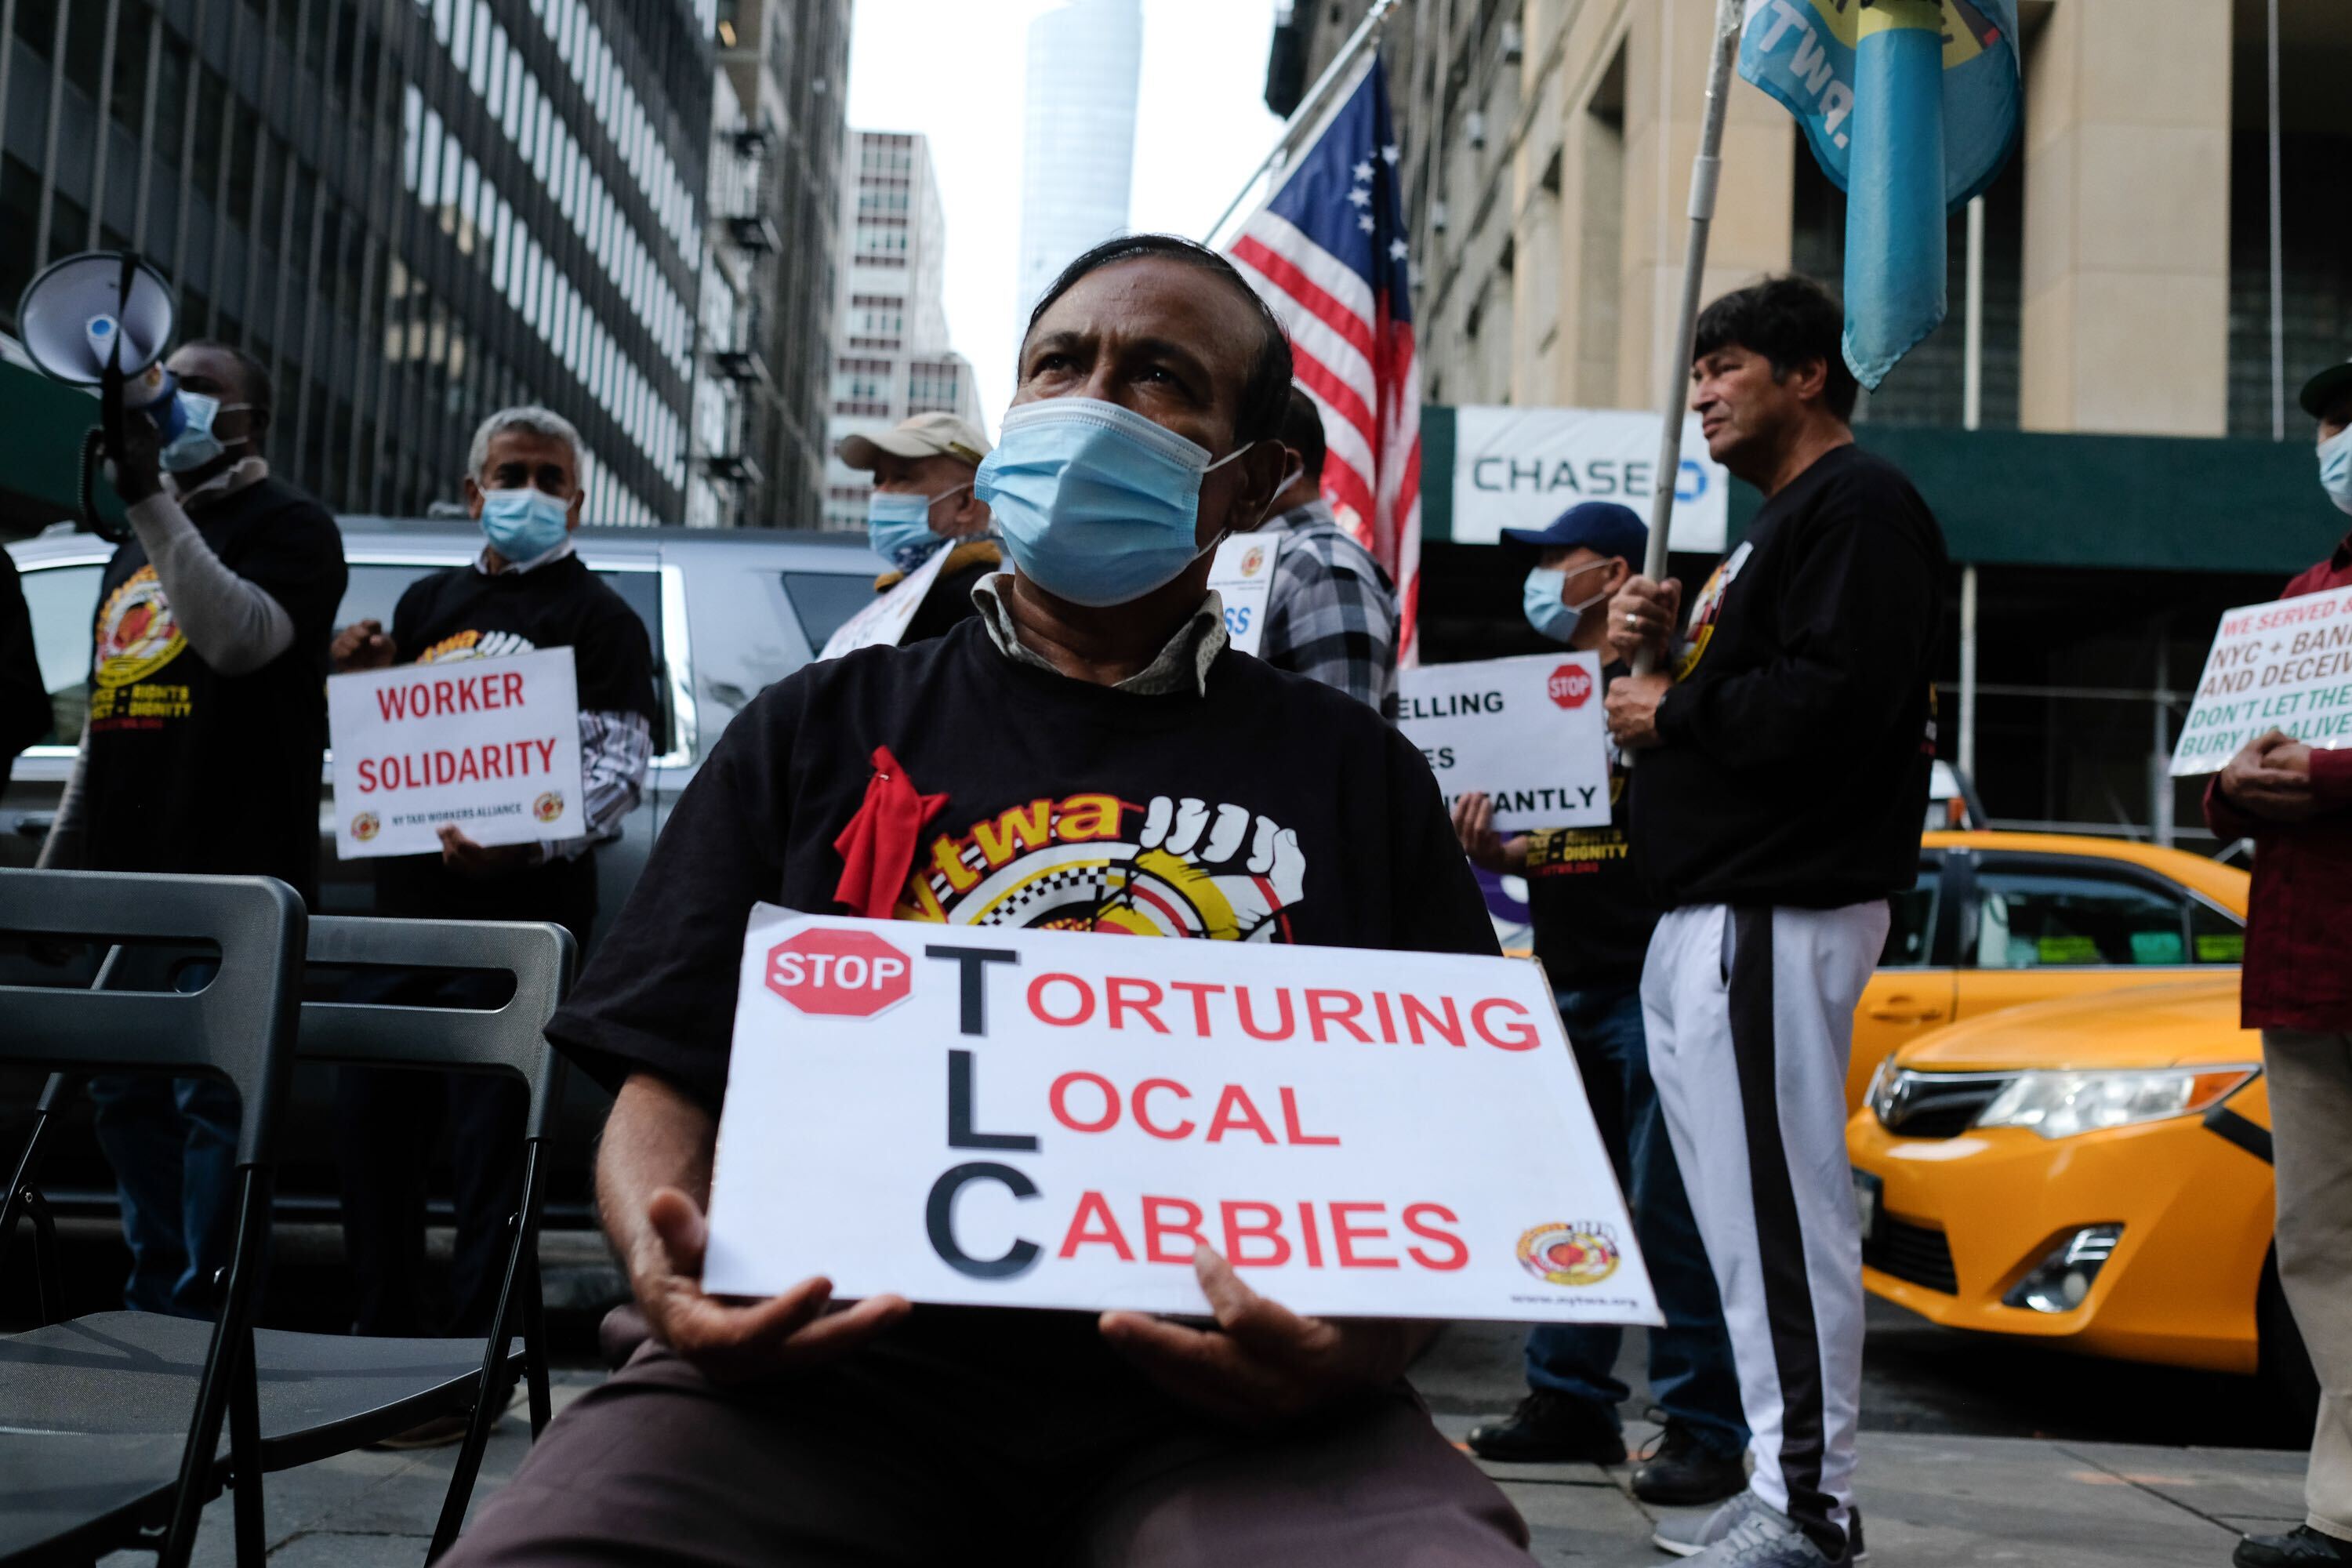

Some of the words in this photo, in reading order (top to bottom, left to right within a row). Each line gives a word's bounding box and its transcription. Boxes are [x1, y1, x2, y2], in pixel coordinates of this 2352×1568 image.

[1474, 456, 1652, 496] CHASE
[2223, 615, 2253, 637] WE
[2258, 600, 2337, 630] SERVED
[2211, 641, 2263, 670] NYC
[2291, 624, 2352, 657] BAN
[376, 672, 524, 723] WORKER
[1548, 676, 1592, 698] STOP
[2200, 669, 2255, 698] AND
[2190, 698, 2260, 730] DON'T
[2262, 691, 2305, 719] LET
[2180, 730, 2245, 758] BURY
[2287, 713, 2352, 741] ALIVE
[358, 738, 556, 795] SOLIDARITY
[427, 807, 474, 822] WORKERS
[477, 804, 522, 820] ALLIANCE
[1563, 843, 1628, 862] DIGNITY
[772, 951, 906, 990] STOP
